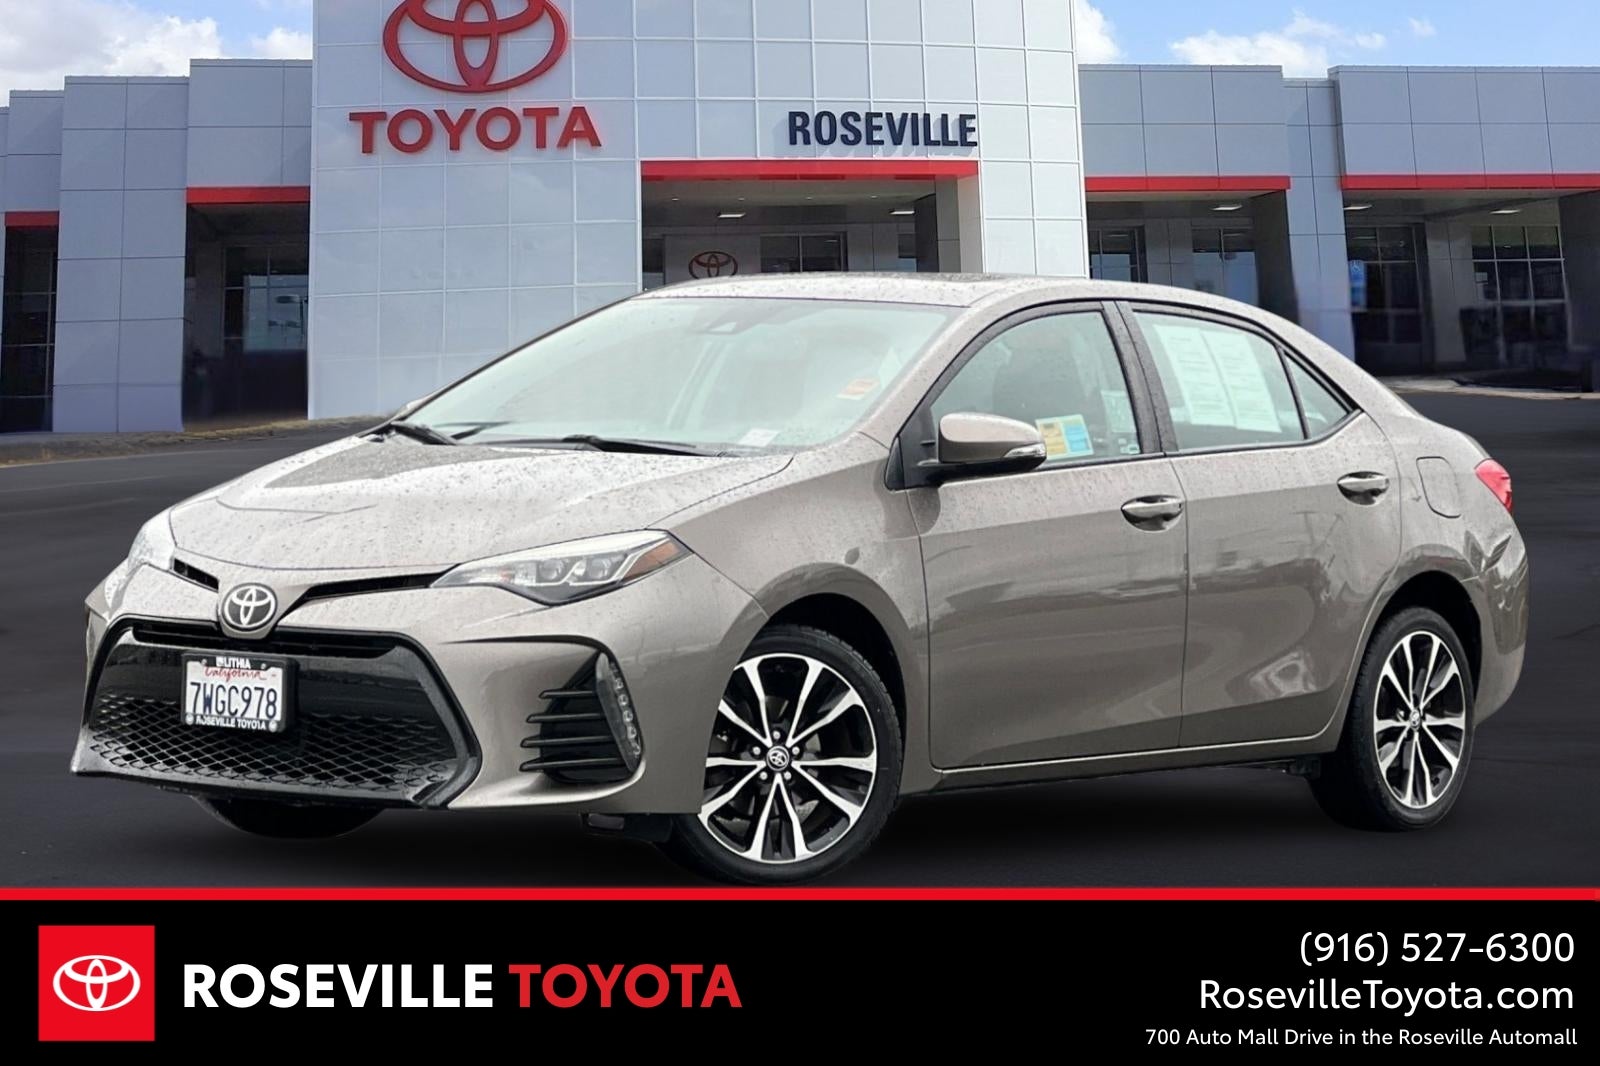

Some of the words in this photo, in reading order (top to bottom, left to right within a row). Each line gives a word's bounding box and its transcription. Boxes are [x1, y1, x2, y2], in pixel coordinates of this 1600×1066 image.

[349, 106, 602, 154] TOYOTA
[788, 110, 978, 147] ROSEVILLE
[224, 657, 251, 669] LITHIA
[190, 682, 278, 719] 7WGC978
[195, 715, 236, 728] ROSEVILLE
[237, 718, 267, 730] TOYOTA
